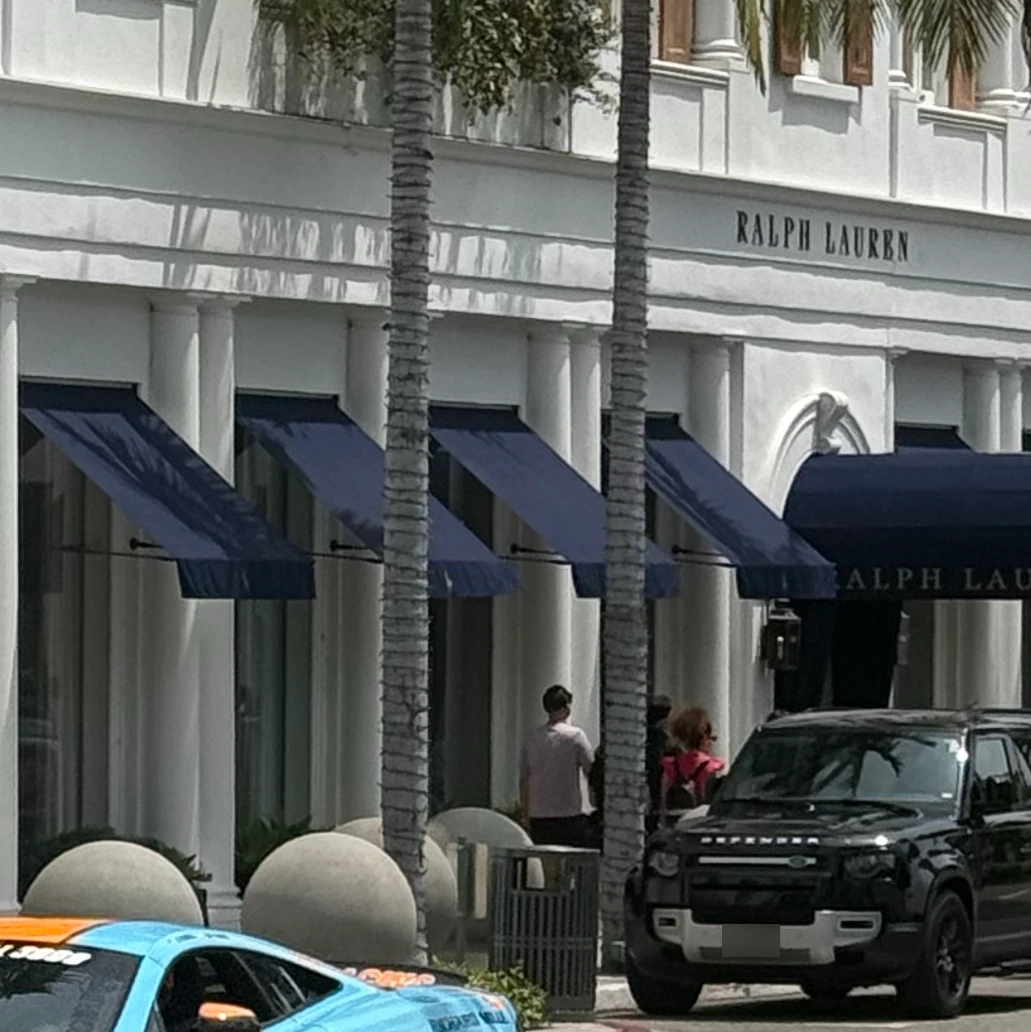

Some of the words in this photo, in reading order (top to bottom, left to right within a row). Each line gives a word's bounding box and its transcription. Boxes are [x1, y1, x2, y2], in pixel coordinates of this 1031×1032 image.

[736, 210, 810, 251] RALPH
[825, 221, 909, 262] LAUREN
[835, 567, 943, 590] ALPH
